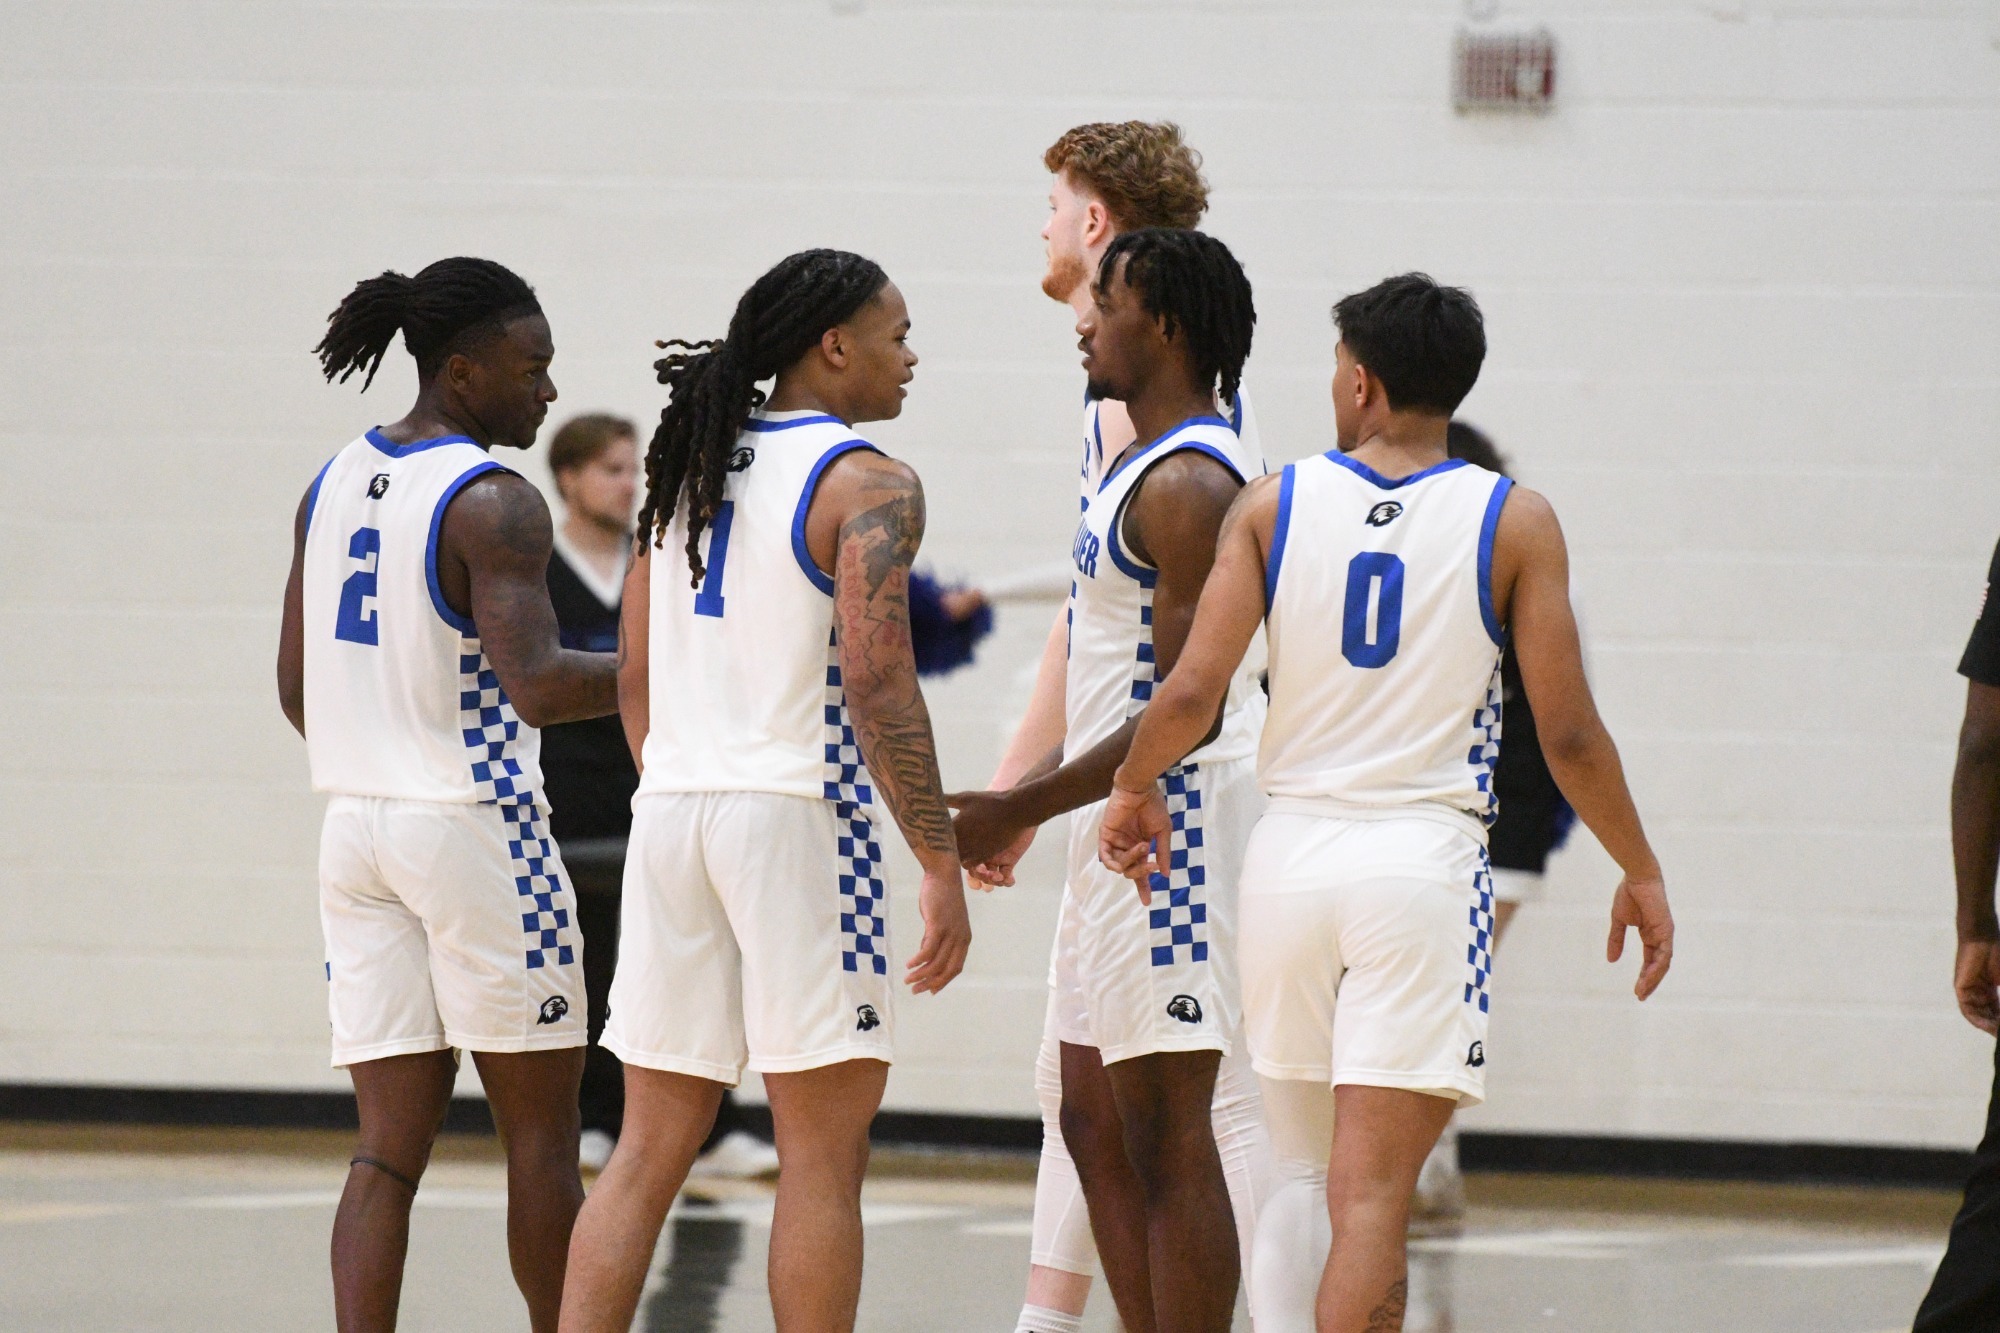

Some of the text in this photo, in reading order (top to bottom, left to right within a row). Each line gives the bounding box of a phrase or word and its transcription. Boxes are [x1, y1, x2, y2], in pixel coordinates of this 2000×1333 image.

[334, 526, 381, 647] 2
[693, 500, 735, 618] 1
[1341, 551, 1405, 669] 0
